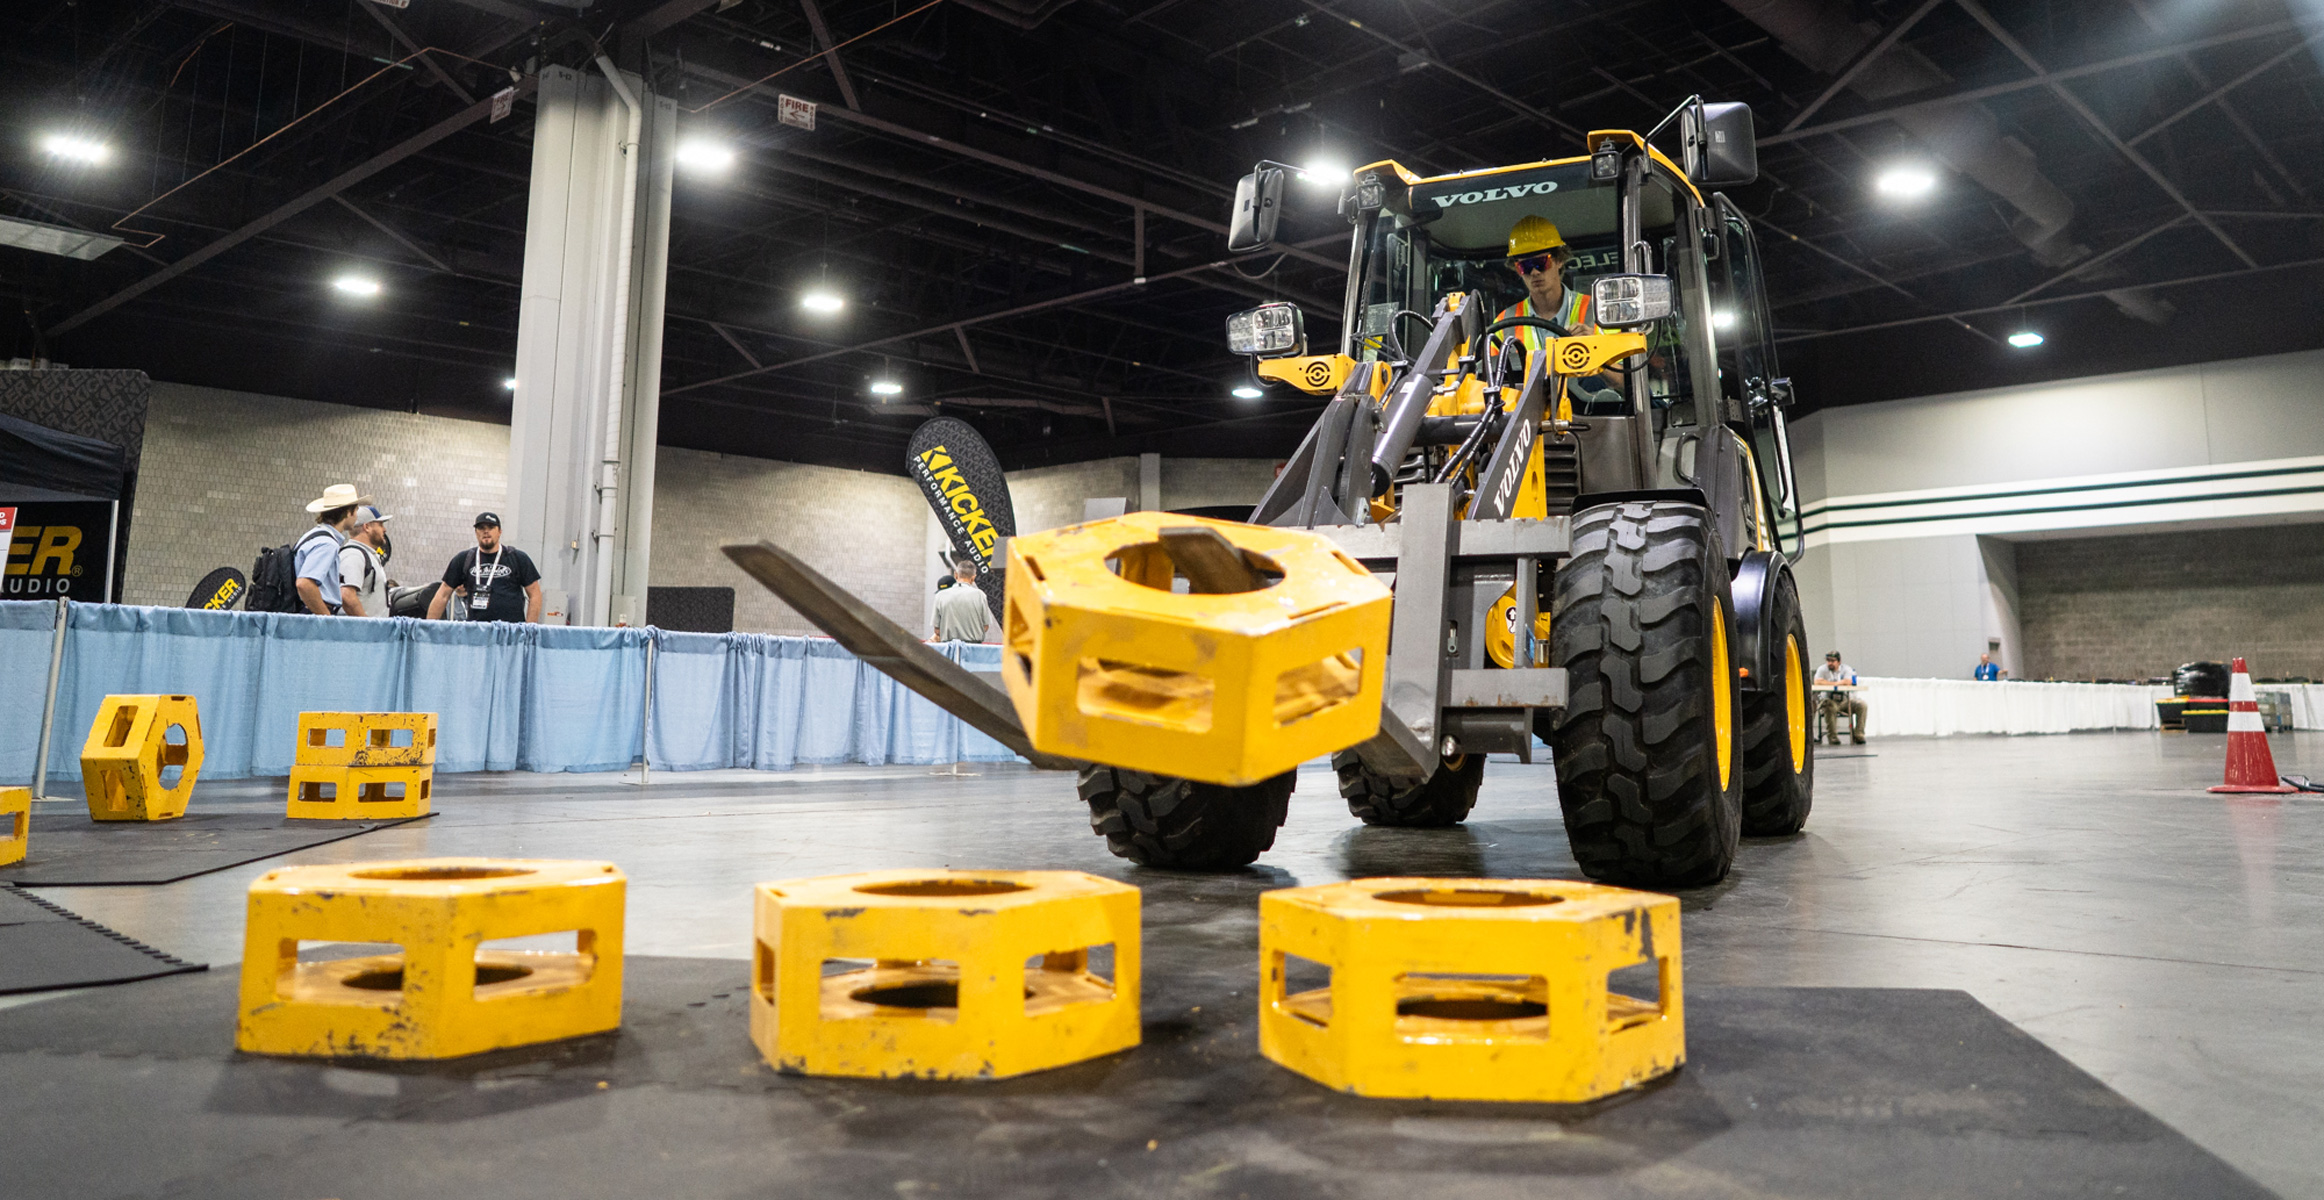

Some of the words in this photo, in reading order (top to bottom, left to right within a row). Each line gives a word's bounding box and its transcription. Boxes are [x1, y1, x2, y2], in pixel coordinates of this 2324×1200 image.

[785, 98, 809, 113] FIRE
[1431, 181, 1558, 208] VOLVO
[913, 456, 965, 534] PERFORMANCE
[965, 540, 989, 574] AUDIO
[1493, 419, 1531, 516] VOLVO
[934, 466, 999, 568] KICKE
